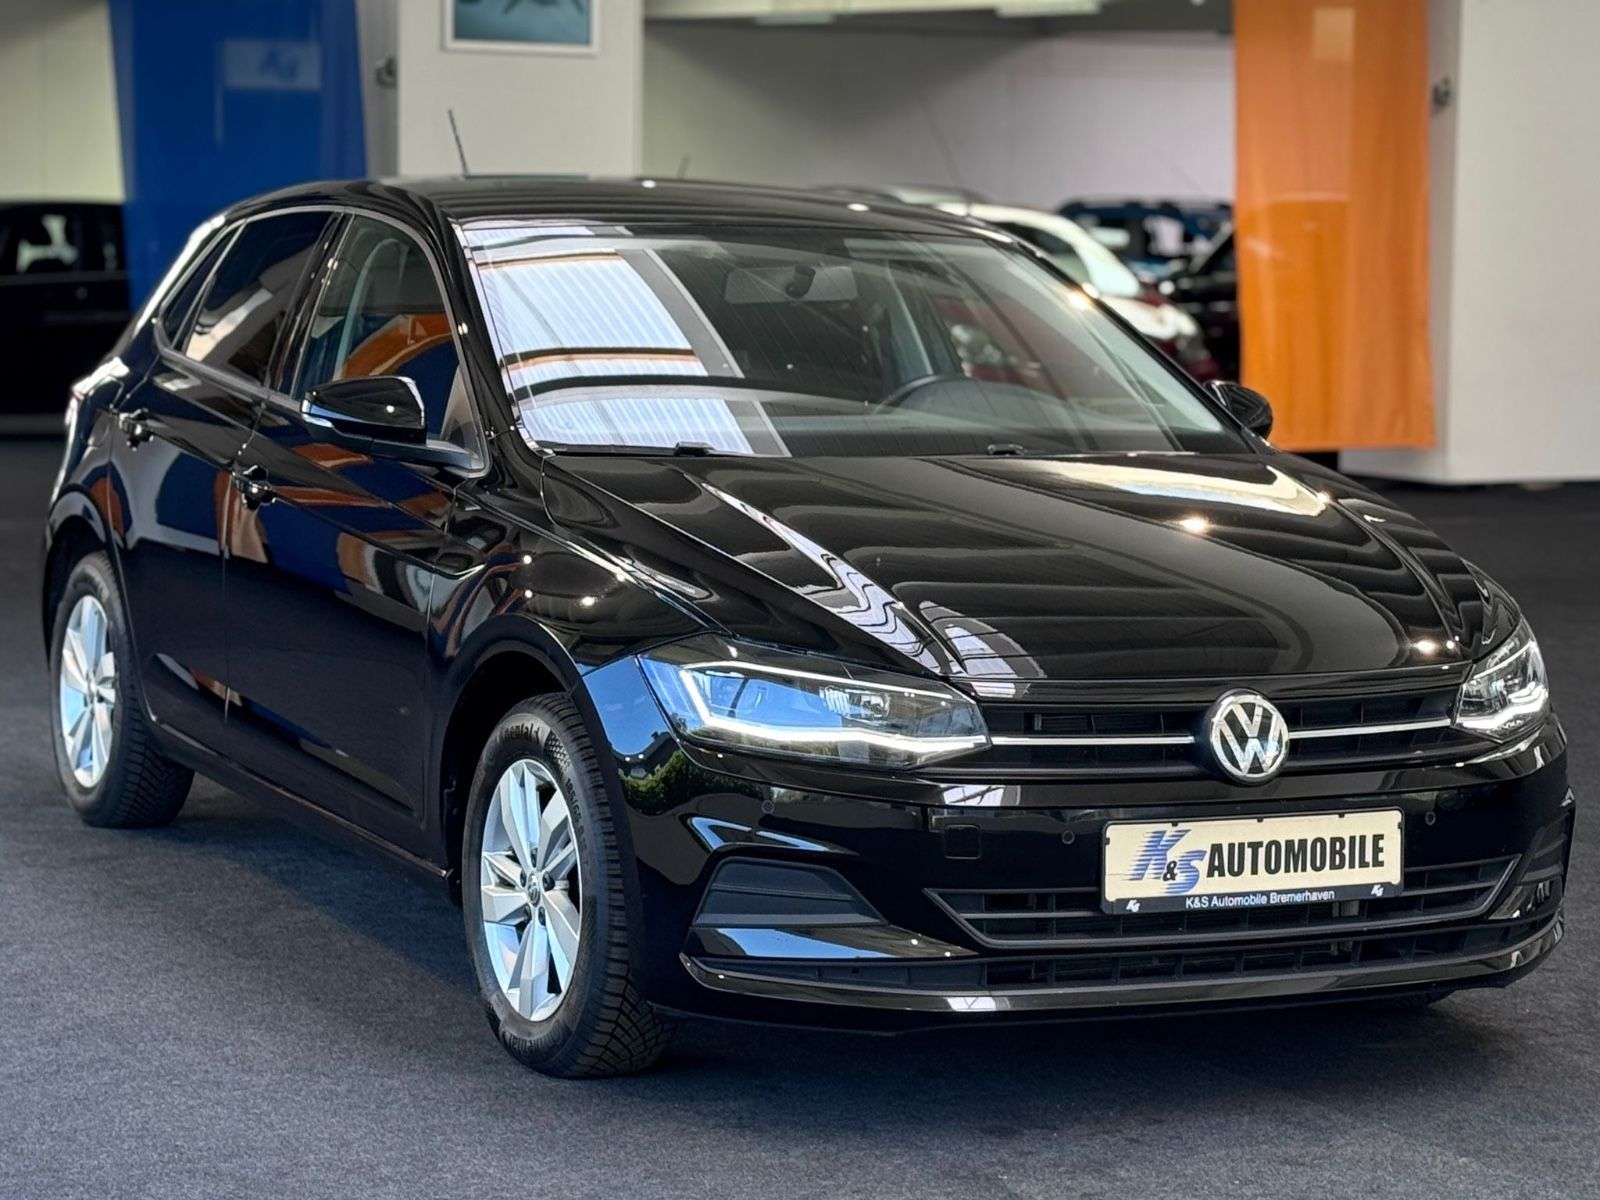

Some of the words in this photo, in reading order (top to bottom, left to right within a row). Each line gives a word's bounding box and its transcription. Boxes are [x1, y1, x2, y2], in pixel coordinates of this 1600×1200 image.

[1213, 697, 1287, 776] VW
[1126, 828, 1207, 895] K&S
[1206, 834, 1385, 878] AUTOMOBILE
[1185, 896, 1209, 910] K&S
[1211, 892, 1268, 908] Automobile
[1269, 889, 1335, 906] Bremerhaven
